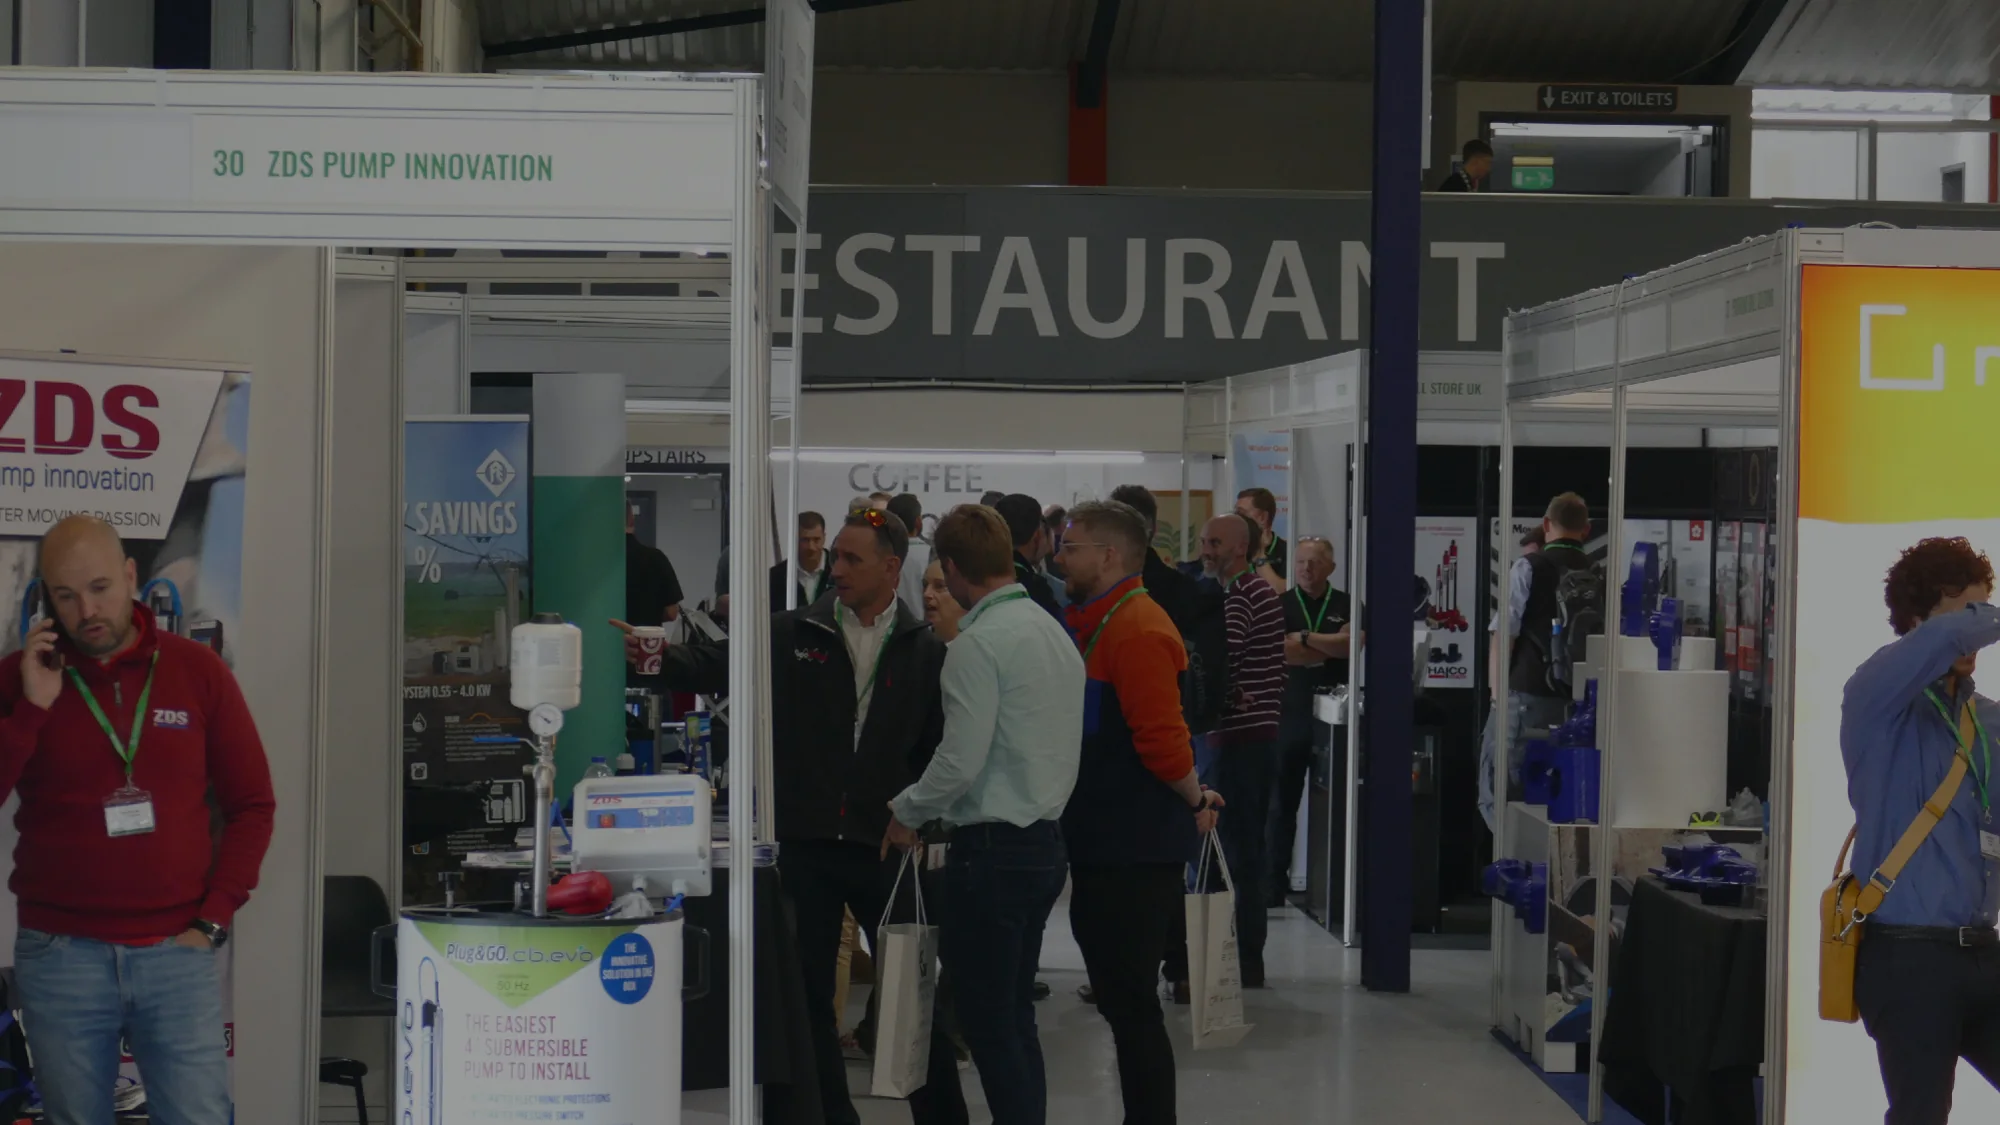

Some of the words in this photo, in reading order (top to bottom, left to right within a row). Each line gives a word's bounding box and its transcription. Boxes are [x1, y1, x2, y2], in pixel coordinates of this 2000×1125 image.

[1561, 91, 1595, 105] EXIT
[1597, 92, 1609, 105] &
[1612, 92, 1673, 107] TOILETS
[213, 149, 245, 178] 30
[267, 150, 315, 178] ZDS
[323, 151, 396, 180] PUMP
[404, 153, 554, 182] INNOVATION
[1430, 382, 1463, 396] STORE
[1467, 383, 1483, 396] UK
[44, 463, 154, 492] innovation
[847, 463, 984, 493] COFFEE
[415, 501, 519, 536] SAVINGS
[459, 684, 475, 698] 4.0
[153, 708, 189, 726] ZDS
[465, 1014, 490, 1033] THE
[496, 1015, 557, 1034] EASIEST
[485, 1039, 589, 1057] SUBMERSIBLE
[465, 1061, 504, 1080] PUMP
[509, 1062, 526, 1081] TO
[531, 1062, 591, 1081] INSTALL
